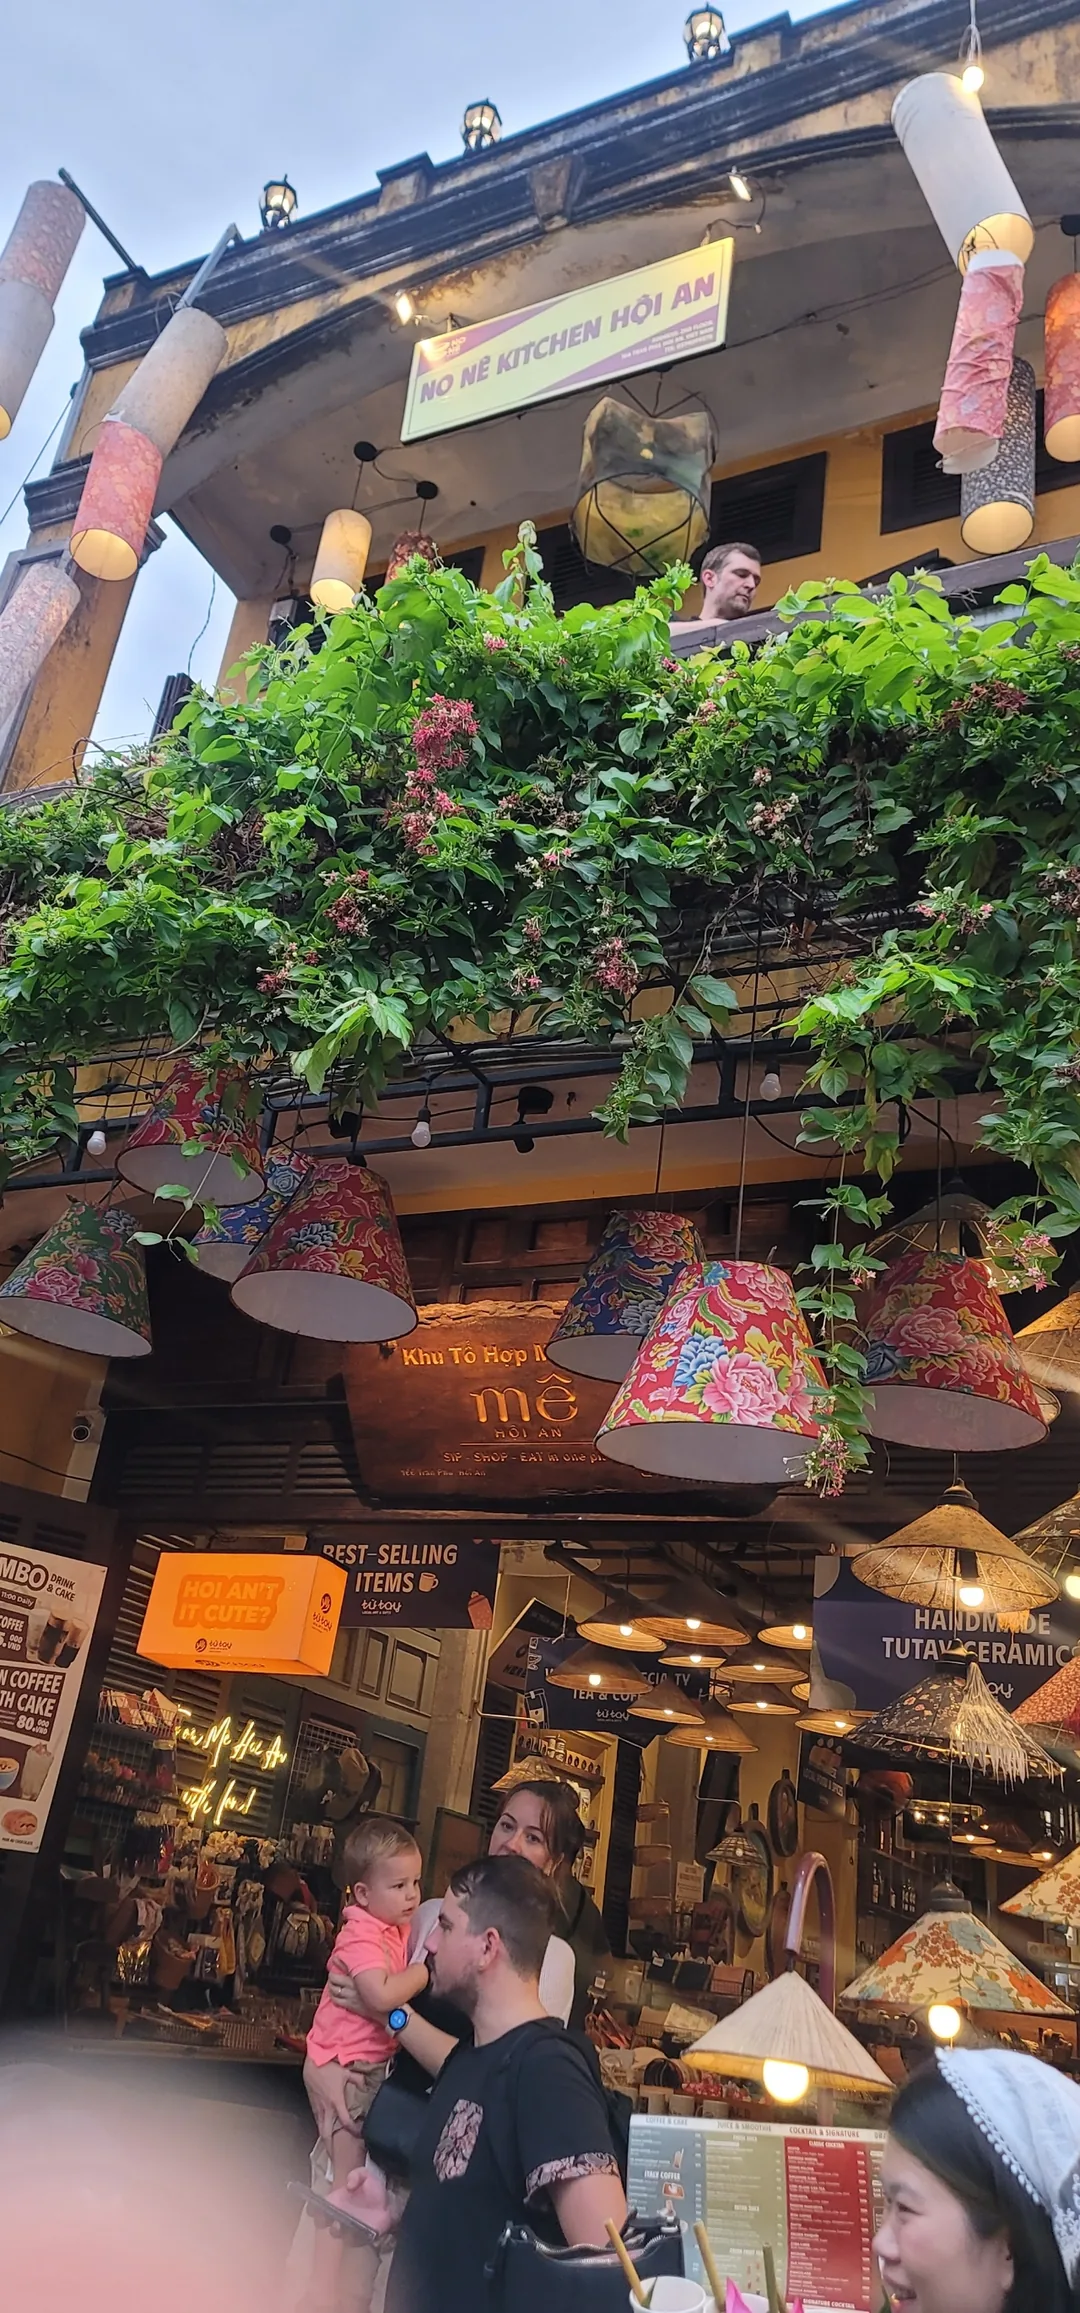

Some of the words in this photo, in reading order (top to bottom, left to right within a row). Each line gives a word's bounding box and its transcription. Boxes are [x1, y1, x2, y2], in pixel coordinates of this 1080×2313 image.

[420, 377, 454, 403] NO
[461, 355, 490, 388] NÊ
[497, 316, 602, 375] KITCHEN
[610, 293, 662, 332] HỘI
[671, 272, 715, 310] AN
[402, 1348, 444, 1365] Khu
[449, 1341, 476, 1364] Tổ
[483, 1343, 527, 1367] Hợp
[469, 1373, 578, 1423] mê
[538, 1427, 563, 1438] AN
[443, 1452, 462, 1462] SIP
[474, 1452, 508, 1462] SHOP
[520, 1452, 543, 1462] EAT
[563, 1453, 586, 1462] one
[0, 1557, 46, 1588] MBO
[50, 1574, 76, 1590] DRINK
[355, 1572, 414, 1593] ITEMS
[46, 1584, 54, 1593] &
[55, 1587, 76, 1602] CAKE
[183, 1581, 222, 1599] HOI
[225, 1581, 279, 1600] AN'T
[17, 1596, 34, 1607] Daily
[179, 1603, 200, 1621] IT
[204, 1604, 271, 1624] CUTE?
[915, 1608, 1050, 1635] HANDMDE
[10, 1670, 63, 1694] COFFEE
[573, 1689, 594, 1700] TEA
[0, 1690, 16, 1709] TH
[17, 1693, 57, 1718] CAKE
[645, 2116, 665, 2125] COFFEE
[717, 2121, 733, 2129] JUICE
[741, 2123, 772, 2132] SMOOTHIE
[789, 2126, 817, 2136] COCKTAIL
[825, 2129, 860, 2138] SIGNATURE
[825, 2141, 845, 2149] COCKTAIL
[644, 2170, 659, 2179] ITALY
[660, 2171, 681, 2181] COFFEE
[803, 2298, 830, 2307] SIGNATURE
[831, 2301, 856, 2310] COCKTAIL
